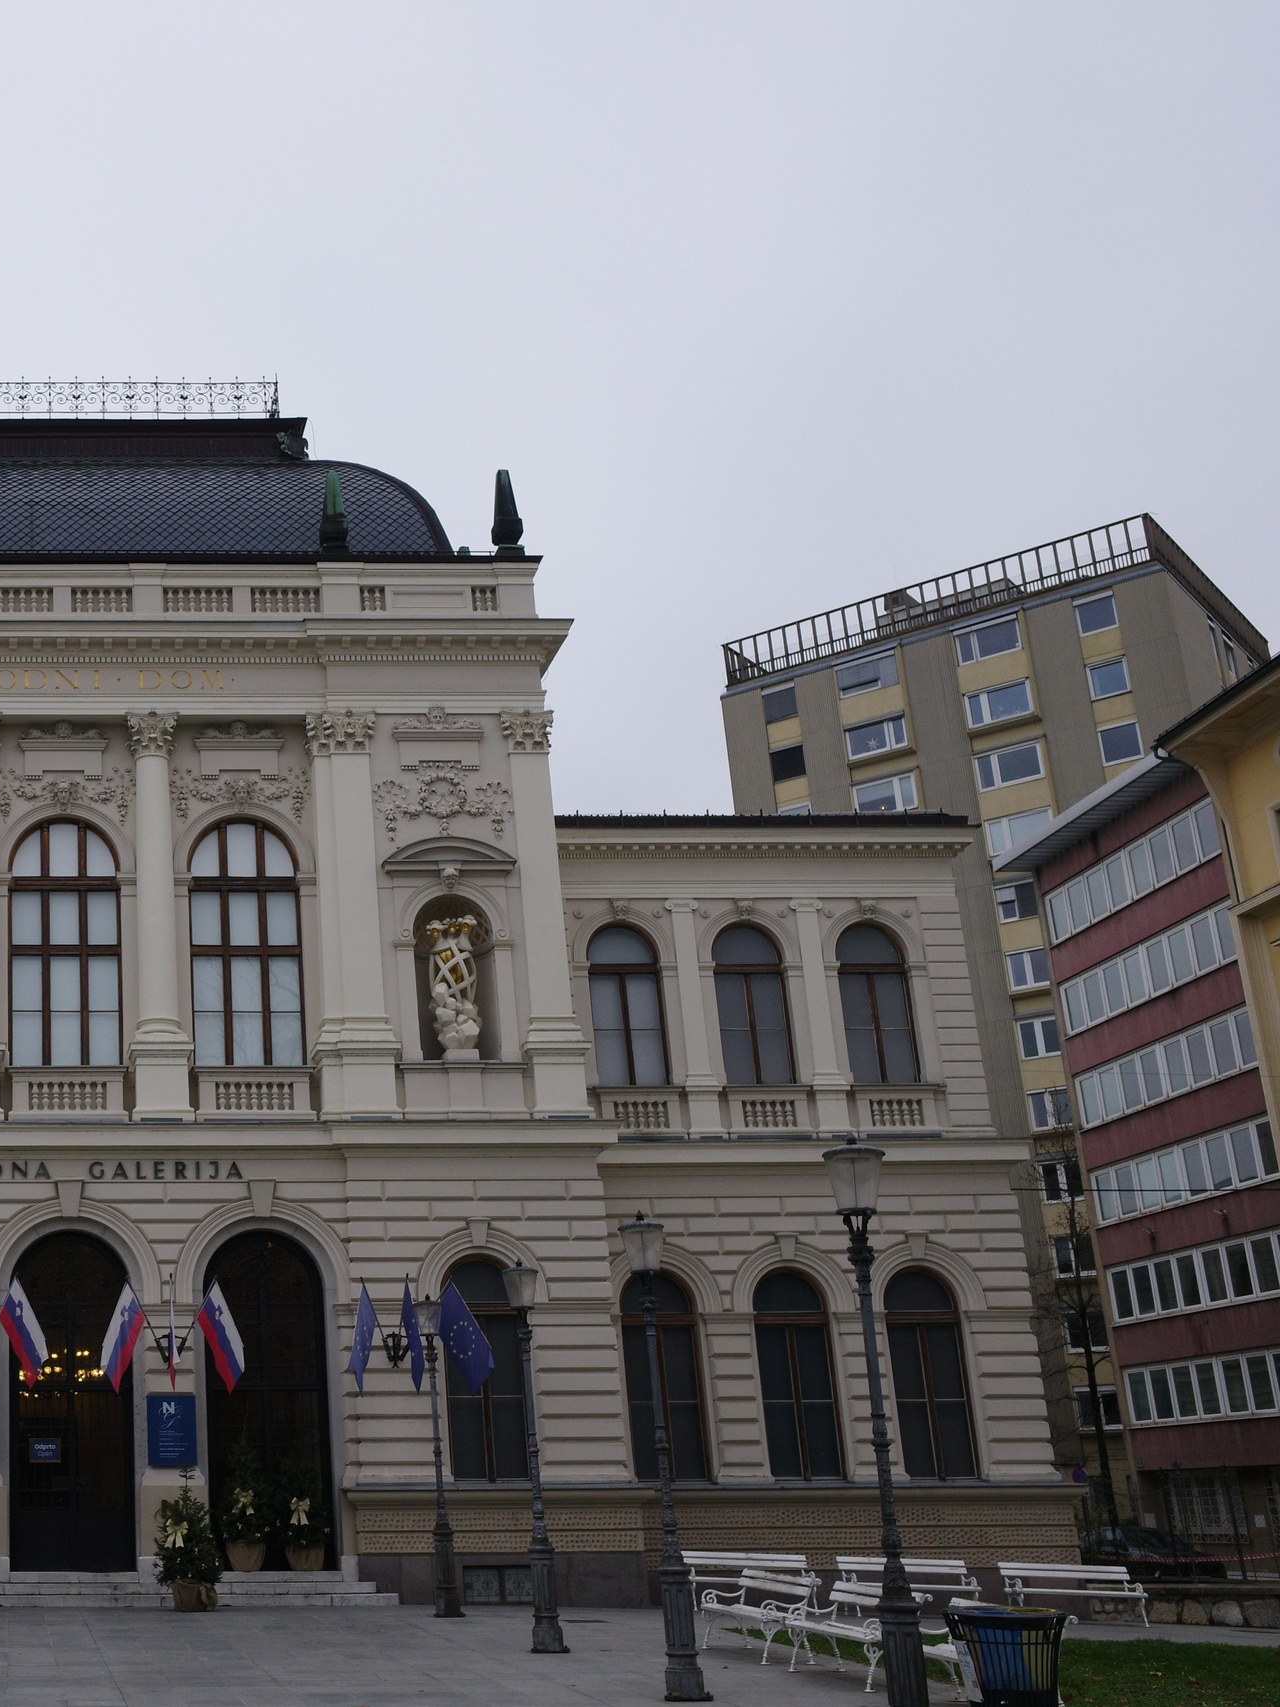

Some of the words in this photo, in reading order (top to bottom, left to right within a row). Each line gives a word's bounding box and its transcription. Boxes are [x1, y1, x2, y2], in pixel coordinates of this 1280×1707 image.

[138, 669, 224, 690] DOM
[88, 1160, 243, 1180] GALERIJA
[34, 1443, 56, 1451] Odprto
[37, 1450, 53, 1458] Open
